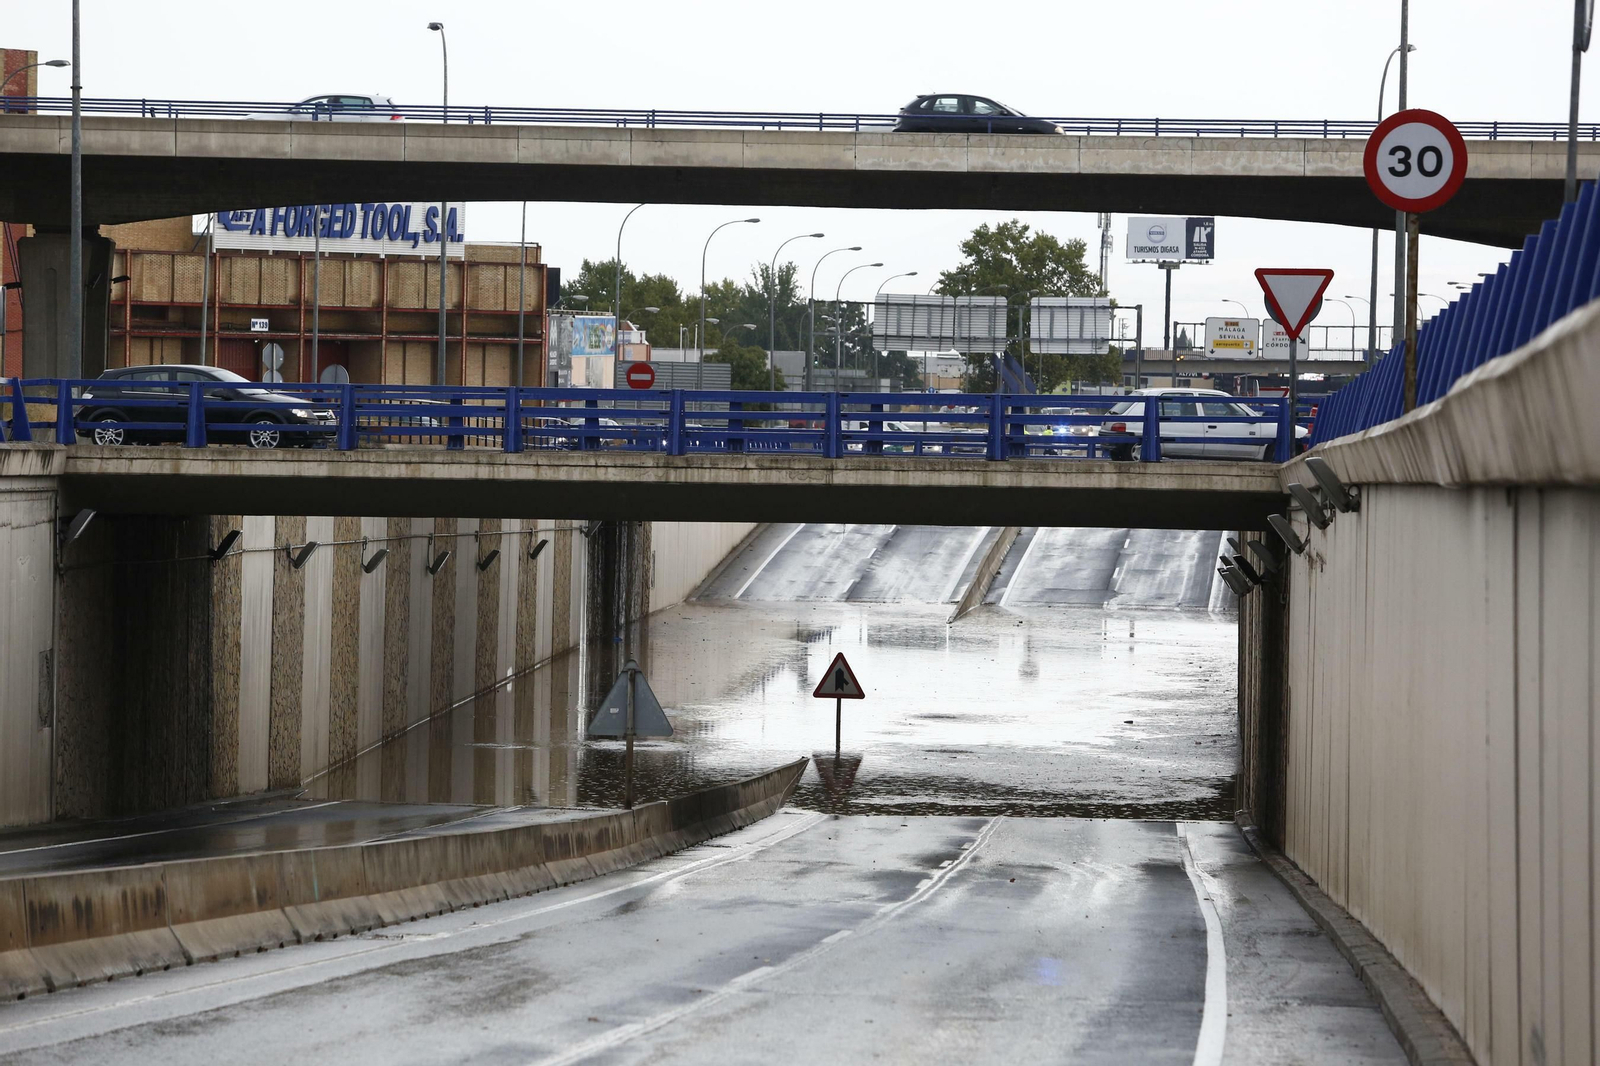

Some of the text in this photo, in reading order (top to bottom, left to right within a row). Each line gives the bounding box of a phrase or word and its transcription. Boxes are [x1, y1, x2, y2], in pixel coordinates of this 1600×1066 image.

[1388, 145, 1443, 178] 30
[231, 211, 254, 222] AFT
[250, 208, 266, 235] A
[270, 204, 357, 238] FORGED
[361, 203, 420, 248] TOOL,
